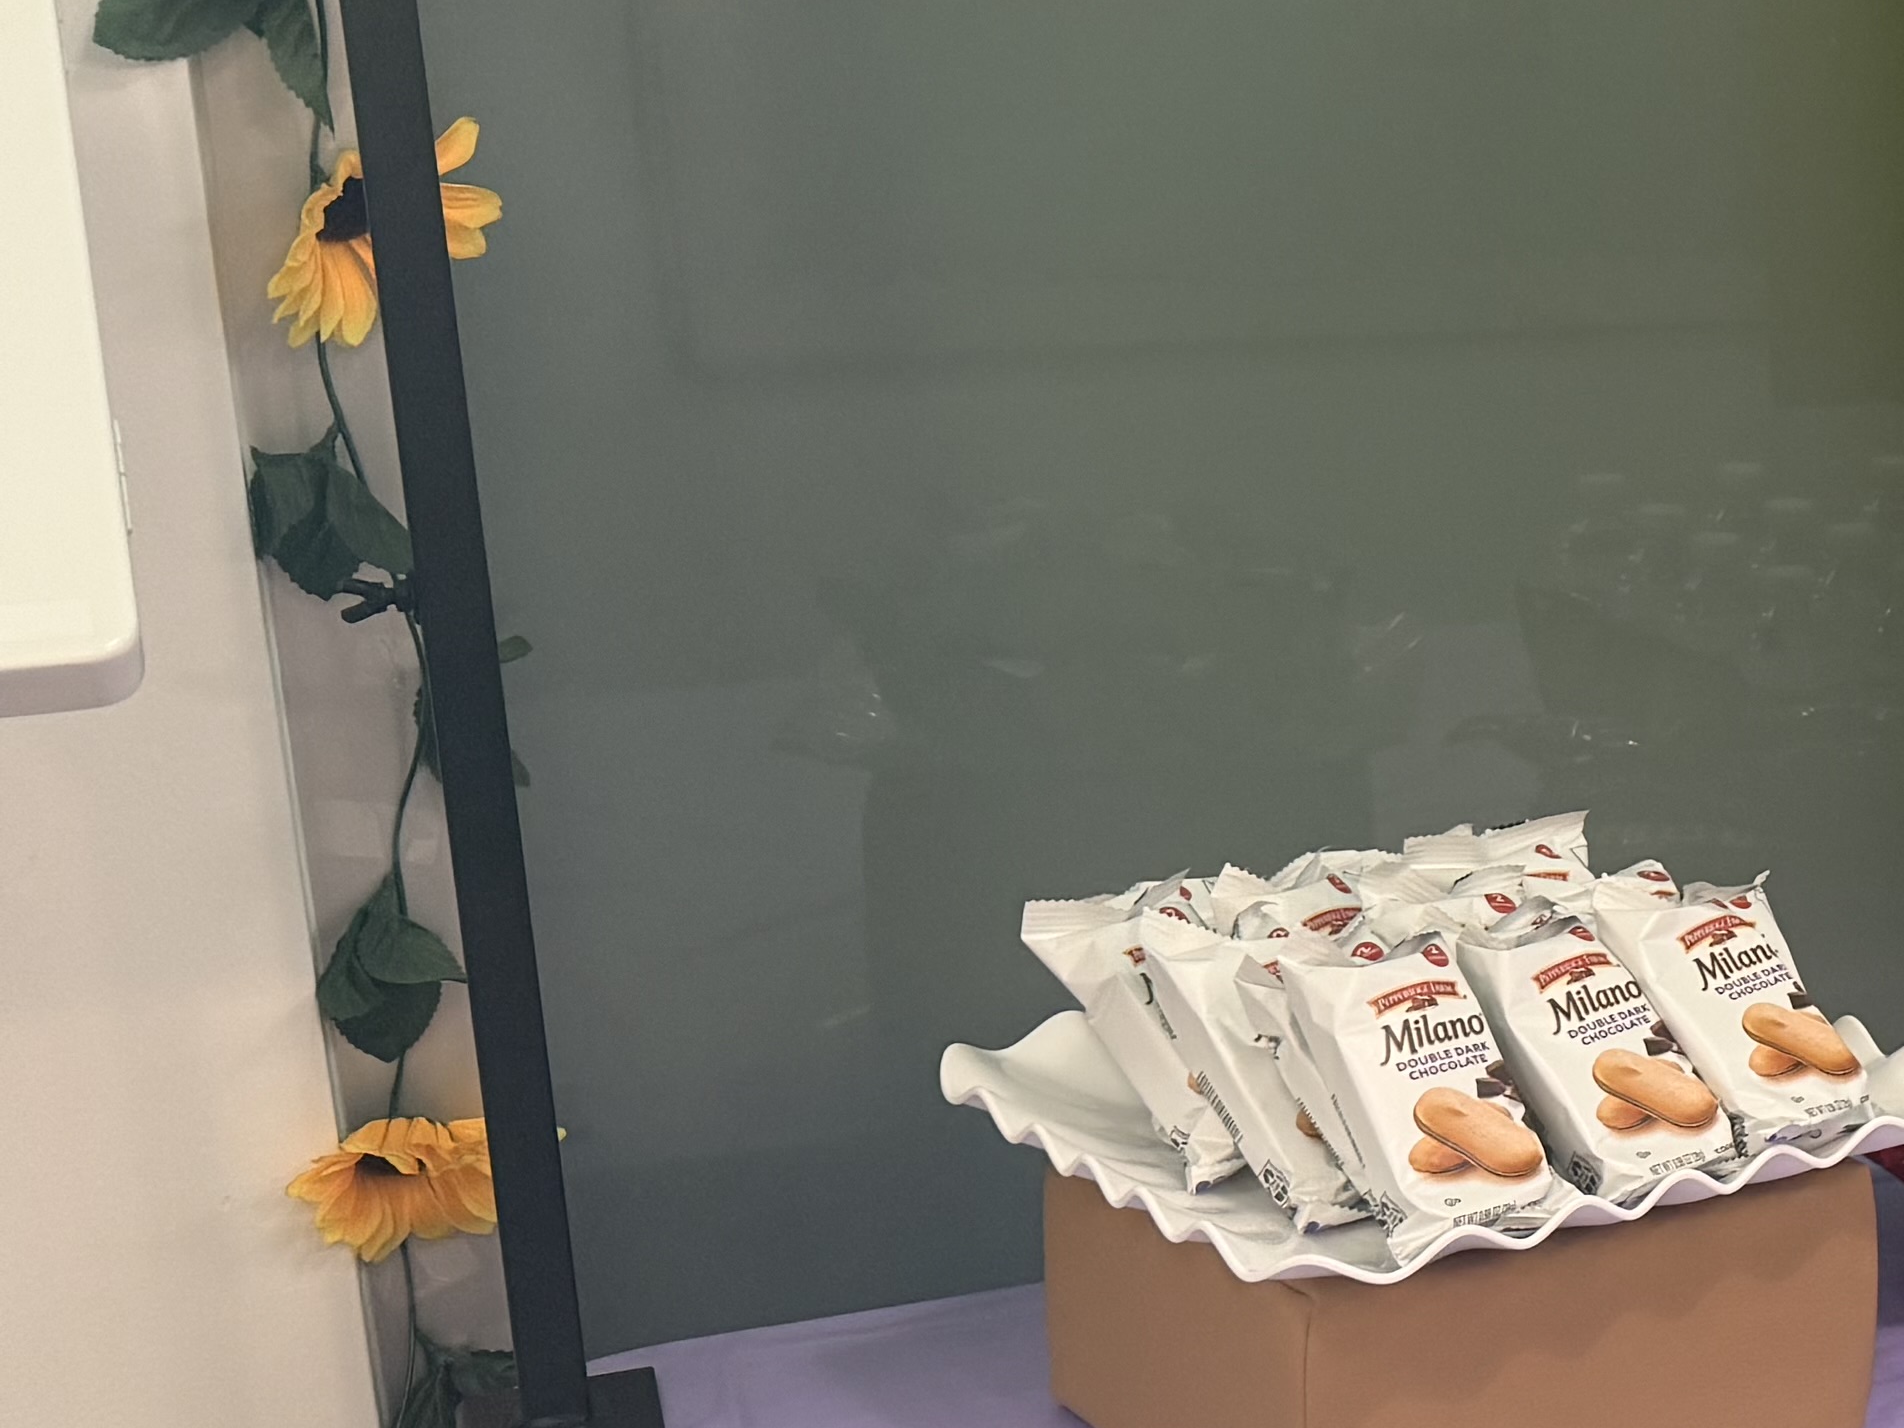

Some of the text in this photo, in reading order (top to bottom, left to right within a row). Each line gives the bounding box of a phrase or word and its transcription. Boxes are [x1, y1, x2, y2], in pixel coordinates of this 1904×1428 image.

[1715, 972, 1762, 995] DOUBLE
[1728, 972, 1793, 1001] CHOCOLATE
[1546, 980, 1642, 1035] Milano
[1567, 1003, 1650, 1039] DOUBLE DARK
[1380, 1013, 1485, 1067] Milano
[1581, 1015, 1651, 1046] CHOCOLATE
[1396, 1041, 1490, 1072] DOUBLE DARK
[1409, 1054, 1488, 1081] CHOCOLATE
